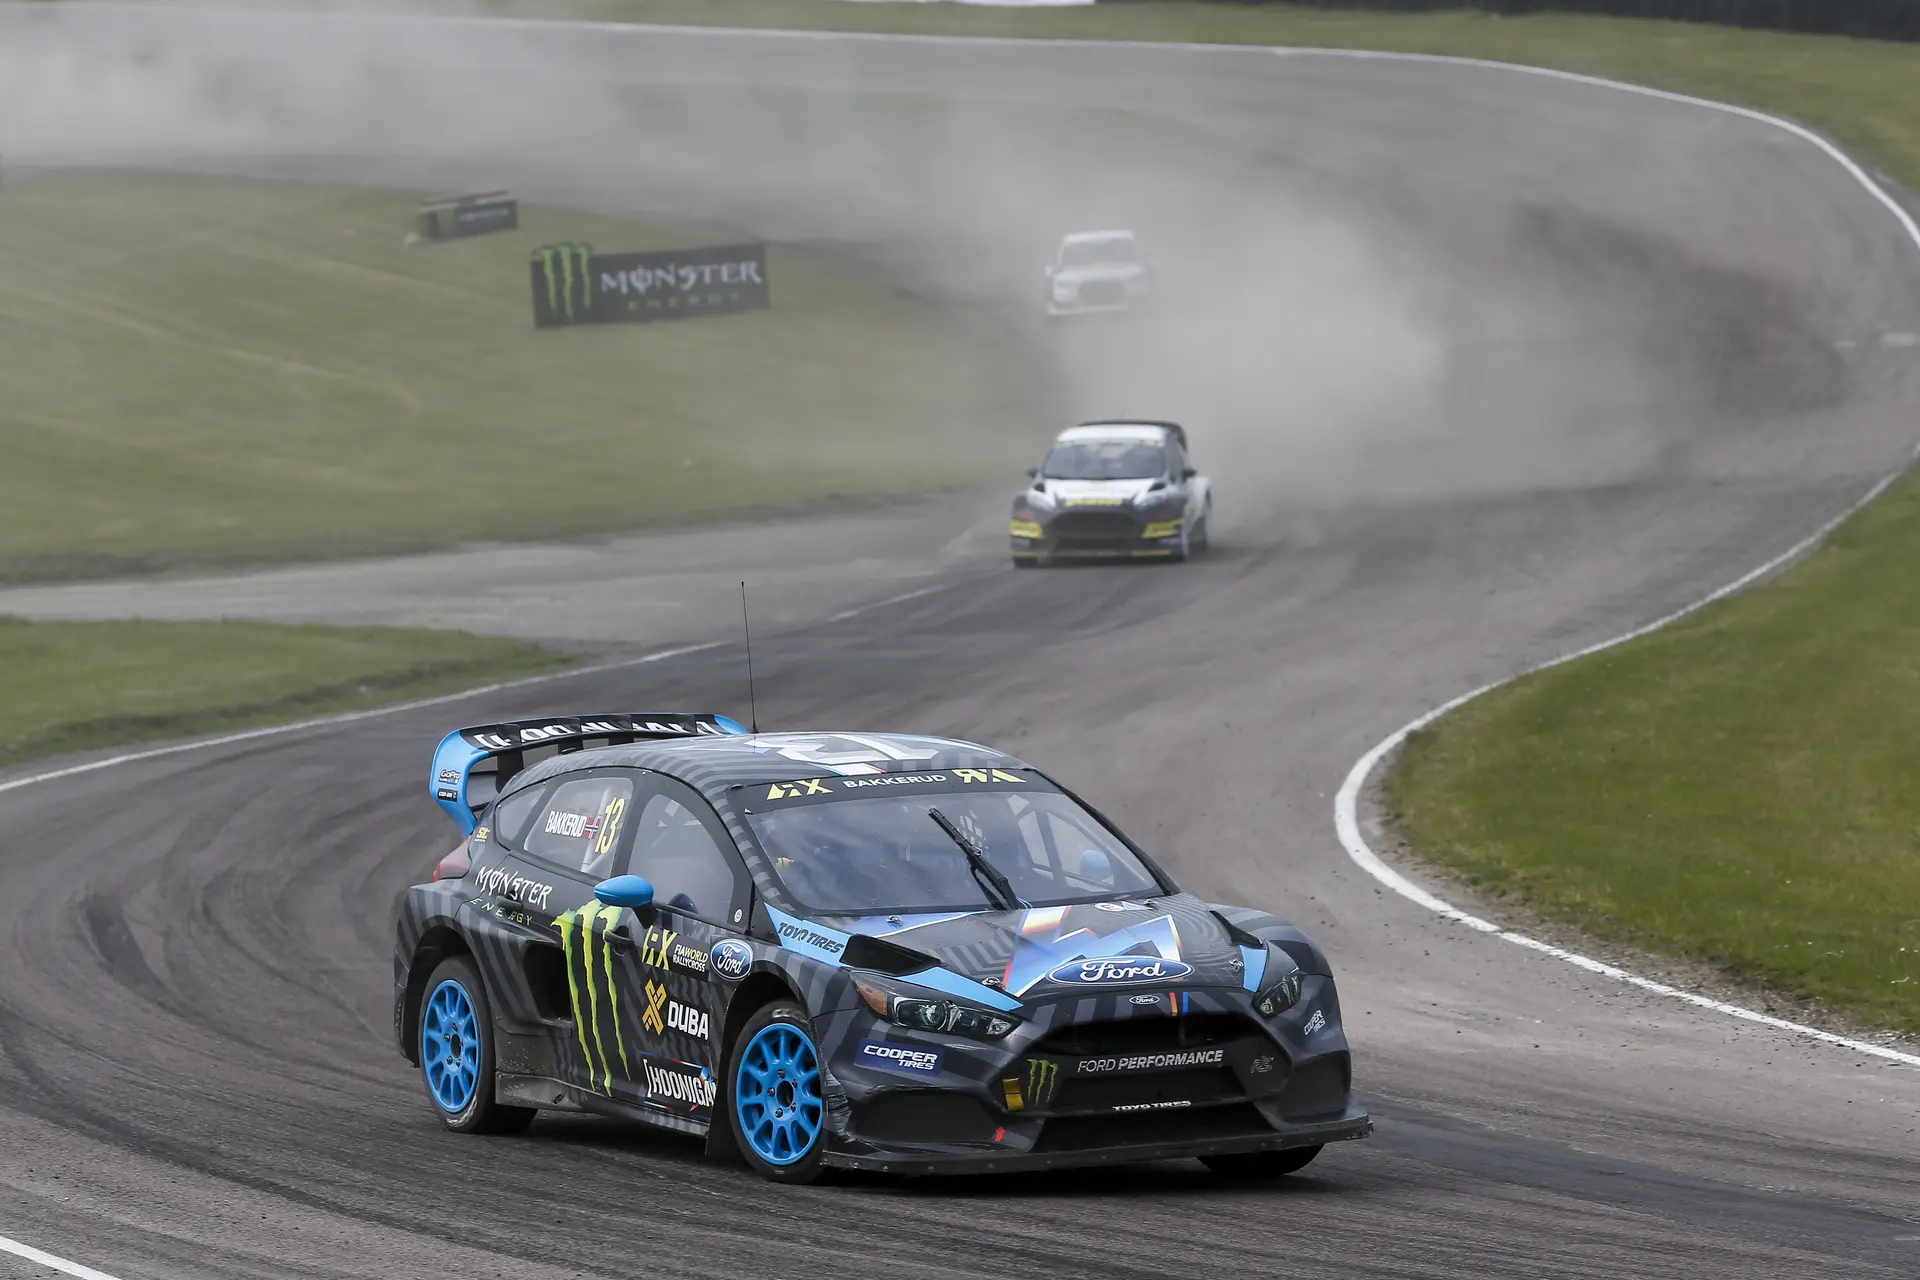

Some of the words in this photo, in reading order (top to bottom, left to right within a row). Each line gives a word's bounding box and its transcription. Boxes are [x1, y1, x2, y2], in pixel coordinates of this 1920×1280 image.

[843, 774, 947, 789] BAKKERUD
[545, 811, 587, 838] BAKKERUD
[595, 797, 624, 855] 13
[470, 897, 533, 926] ENERGY
[778, 922, 809, 941] TOYO
[806, 934, 845, 954] TIRES
[672, 955, 706, 973] RALLYCROSS
[717, 943, 746, 974] Ford
[1080, 959, 1167, 982] Ford
[1135, 996, 1155, 1004] Ford
[667, 1000, 709, 1040] DUBA
[1303, 1009, 1324, 1036] COOPER
[863, 1044, 938, 1063] COOPER
[898, 1059, 935, 1070] TIRES
[1077, 1058, 1116, 1073] FORD
[1117, 1050, 1224, 1070] PERFORMANCE
[1112, 1103, 1151, 1112] TOYO
[1150, 1100, 1192, 1110] TIRES
